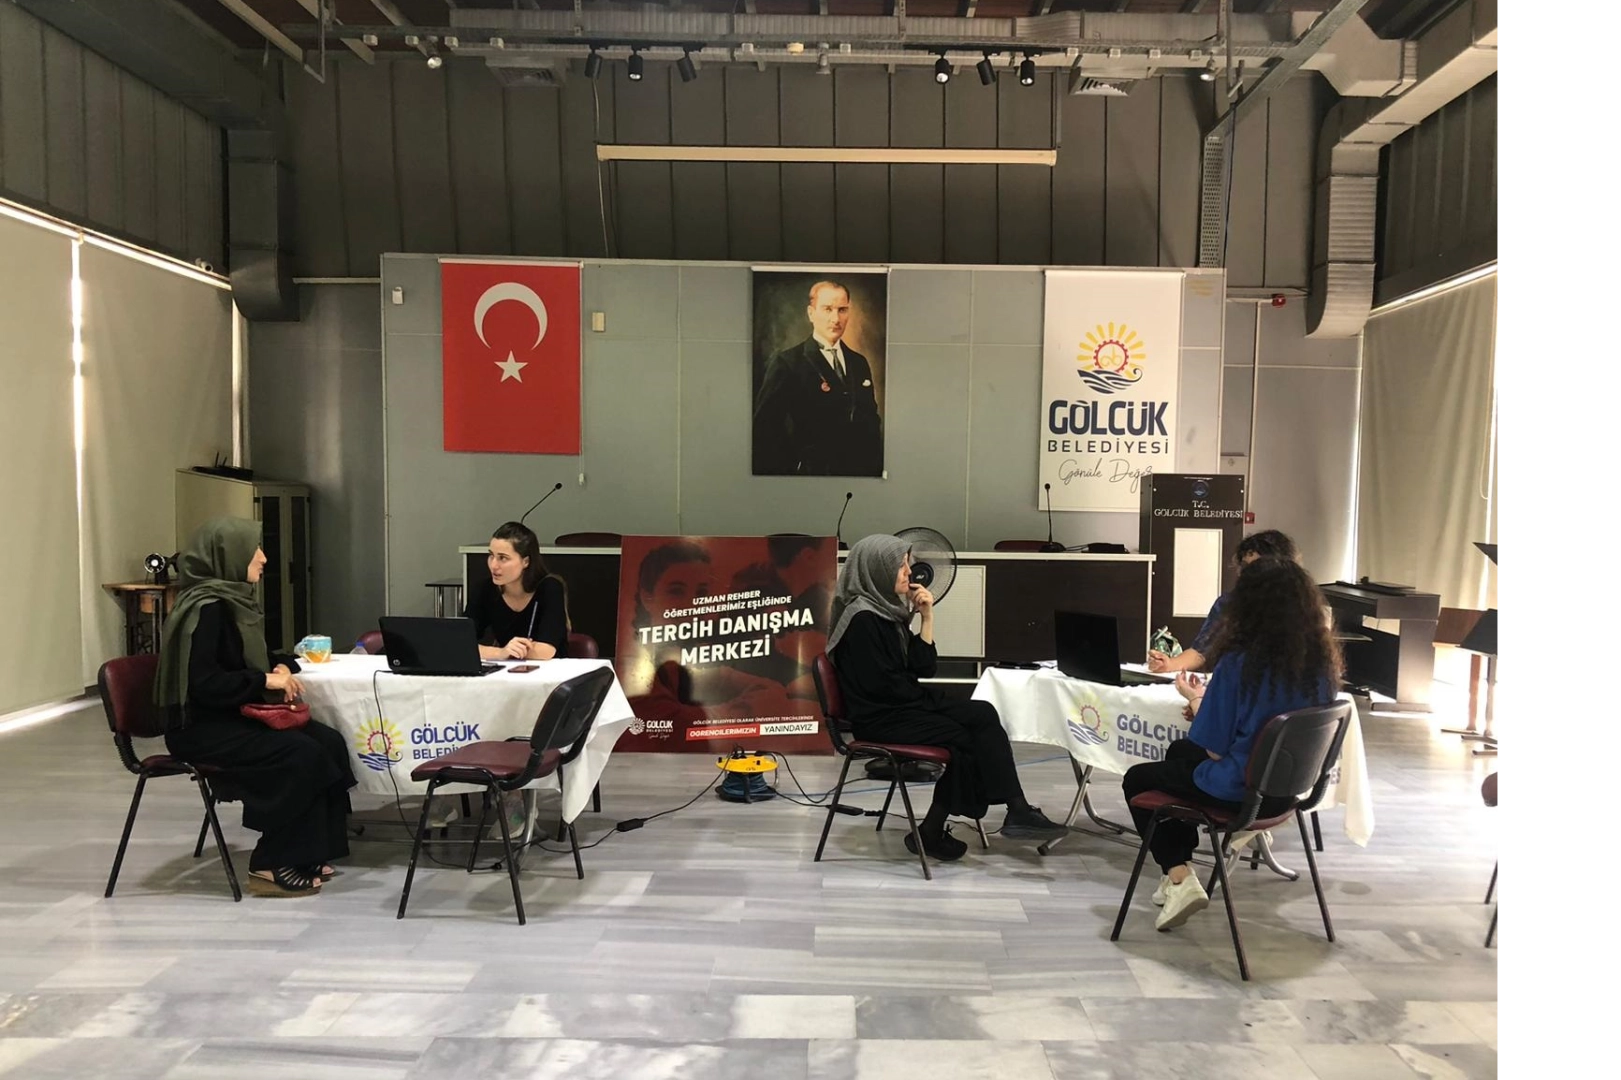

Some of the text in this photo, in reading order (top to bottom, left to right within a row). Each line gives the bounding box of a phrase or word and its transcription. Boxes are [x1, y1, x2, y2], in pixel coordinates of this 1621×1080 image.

[1049, 400, 1168, 435] GÖLCÜK
[1048, 438, 1168, 454] BELEDİYESİ
[663, 595, 792, 619] ÖĞRETMENLERİMİZ EŞLİĞİNDE
[692, 590, 761, 605] UZMAN REHBER
[639, 608, 814, 645] TERCİH DANIŞMA
[680, 634, 771, 666] MERKEZİ
[411, 721, 480, 744] GÖLCÜK
[764, 723, 813, 733] YANINDAYIZ
